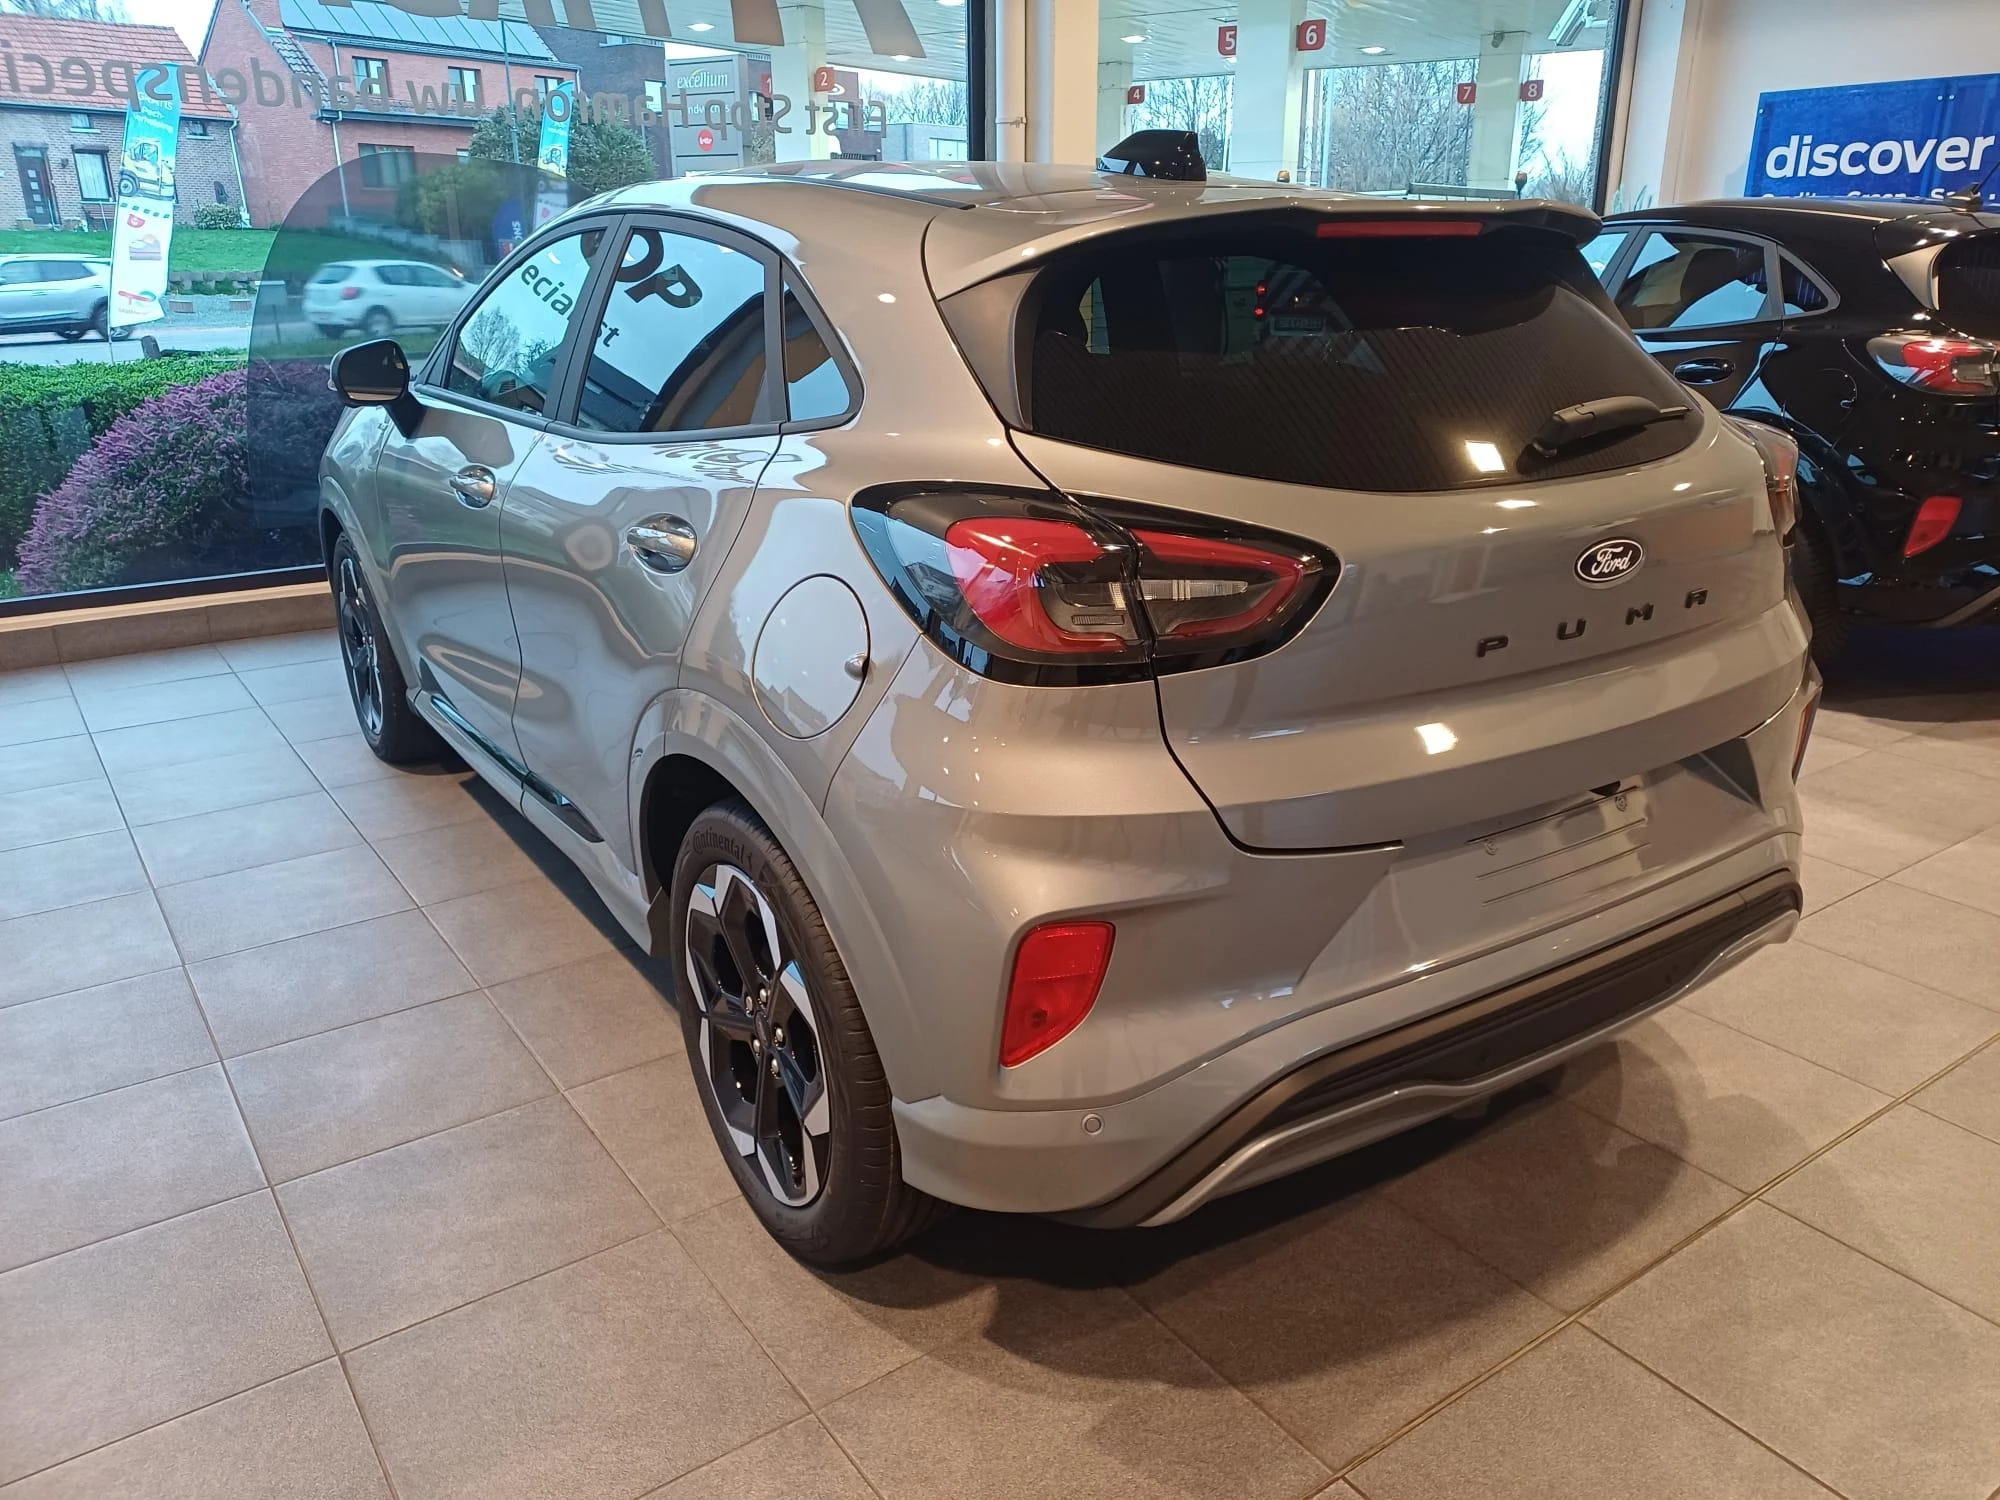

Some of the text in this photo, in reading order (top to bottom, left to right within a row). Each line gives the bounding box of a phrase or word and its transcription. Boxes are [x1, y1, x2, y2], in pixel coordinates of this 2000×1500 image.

[1225, 31, 1236, 50] 5
[1305, 25, 1317, 45] 6
[676, 71, 728, 89] excellium
[820, 71, 828, 87] 2
[1133, 88, 1141, 100] 4
[1463, 86, 1472, 100] 7
[1527, 83, 1538, 98] 8
[1766, 134, 1996, 179] discover
[1591, 546, 1633, 575] Ford
[1477, 588, 1709, 658] PUMA
